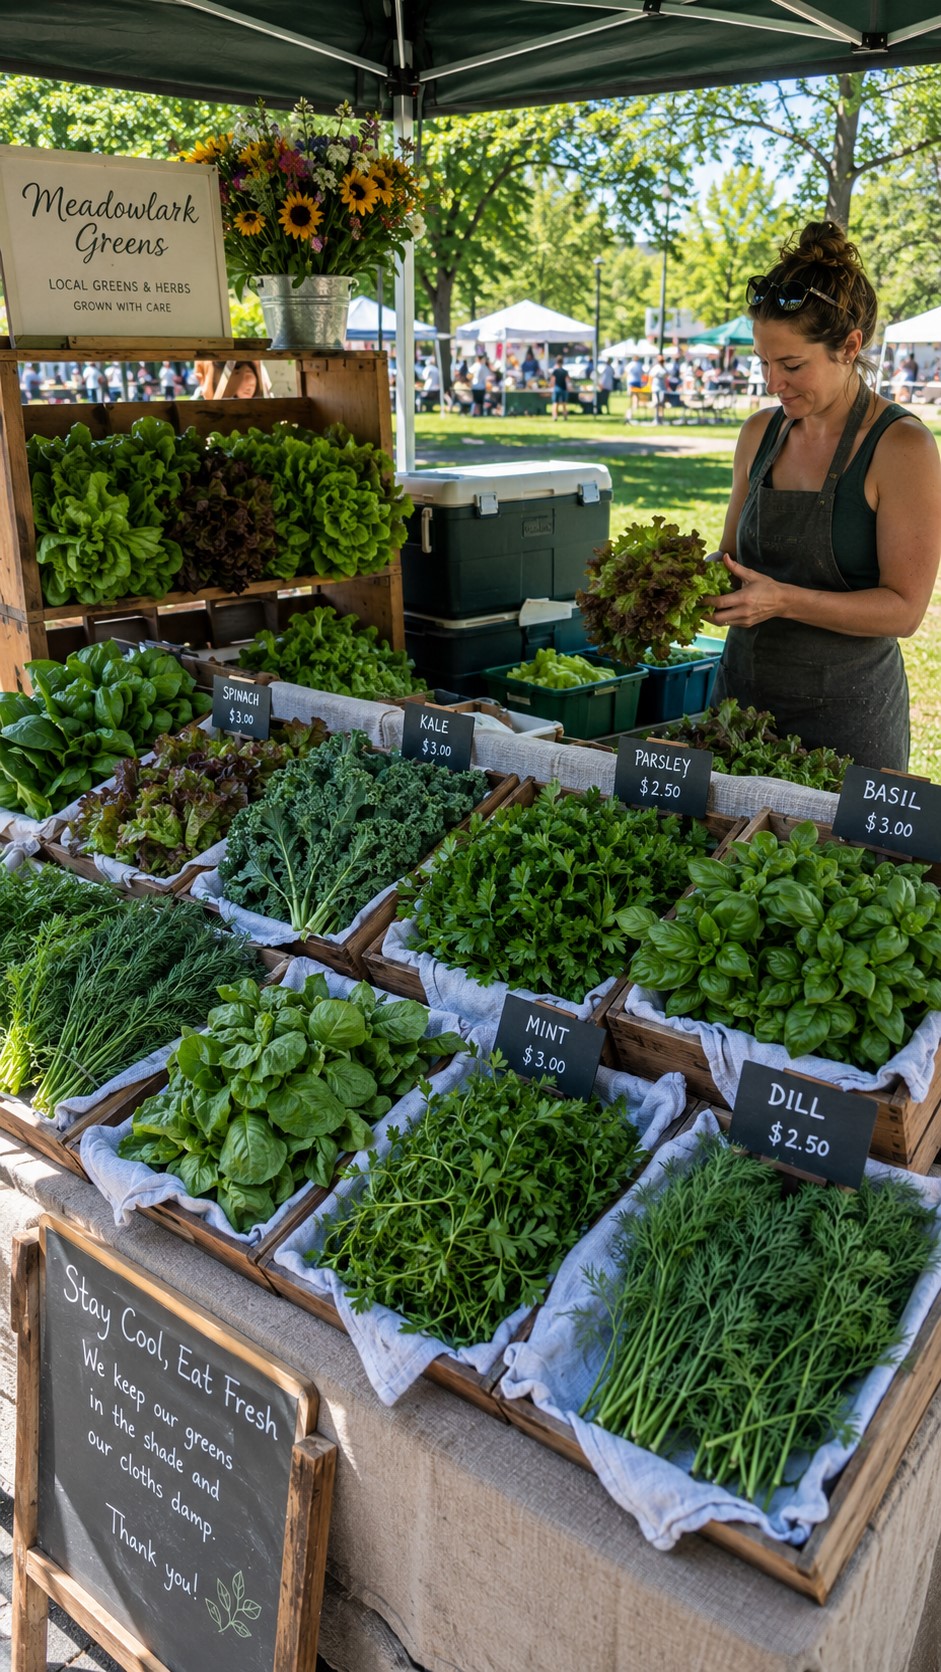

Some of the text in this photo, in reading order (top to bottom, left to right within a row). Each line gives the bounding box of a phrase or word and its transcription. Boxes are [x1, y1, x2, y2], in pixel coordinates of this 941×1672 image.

[22, 182, 199, 223] Meadowlark
[75, 222, 168, 264] Greens
[49, 278, 191, 294] LOCAL GREENS & HERBS
[73, 300, 172, 313] GROWN WITH CARE
[223, 686, 259, 706] SPINACH
[420, 714, 449, 734] KALE
[635, 749, 691, 778] PARSLEY
[863, 780, 921, 810] BASIL
[525, 1014, 570, 1045] MINT
[767, 1082, 825, 1120] DILL
[64, 1264, 278, 1440] Stay Cool, Eat Fresh
[82, 1338, 233, 1470] We keep our greens
[90, 1388, 220, 1501] in the shade and
[88, 1430, 216, 1542] our cloths damp.
[105, 1502, 198, 1600] Thank you!
